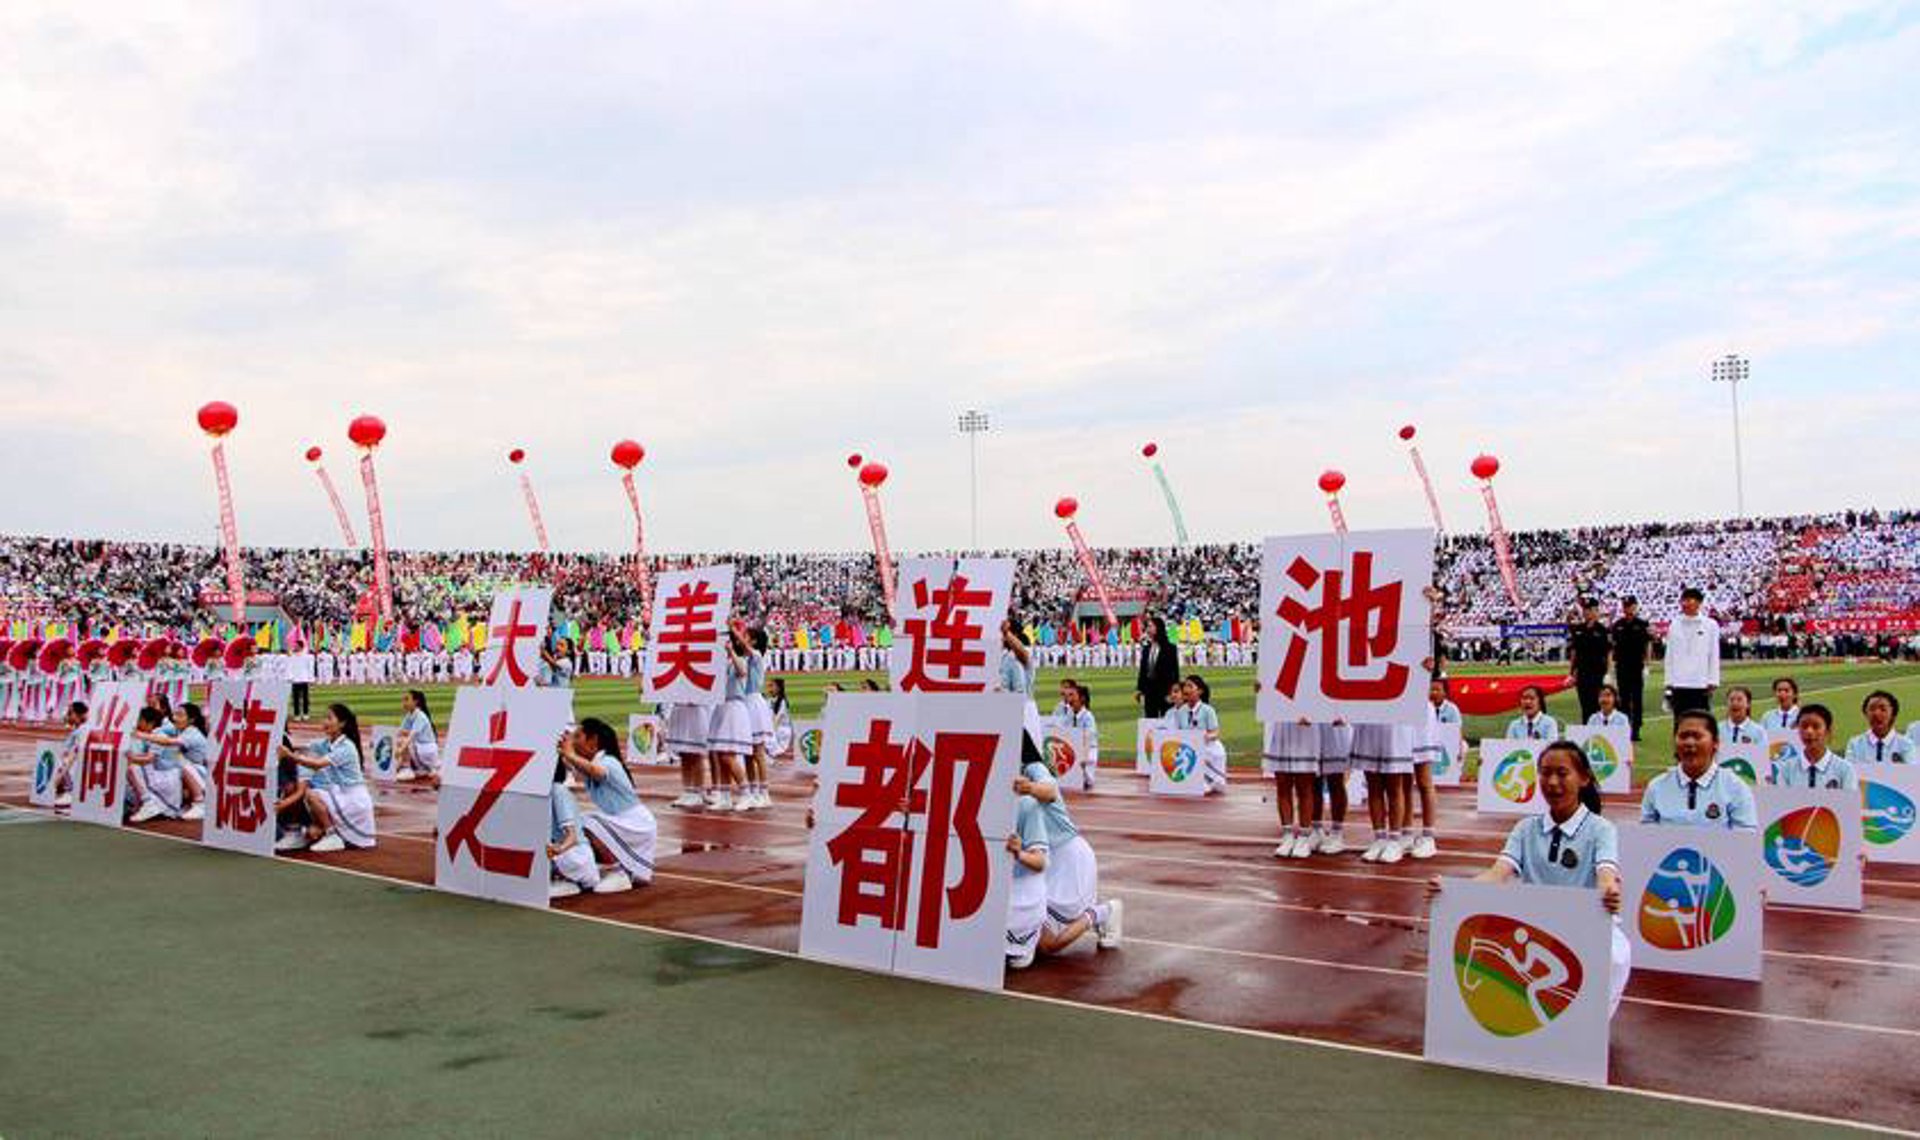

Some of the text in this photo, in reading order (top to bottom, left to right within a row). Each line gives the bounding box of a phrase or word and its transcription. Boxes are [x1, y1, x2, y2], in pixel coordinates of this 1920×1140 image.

[487, 600, 537, 686] 大
[653, 581, 718, 691] 美
[902, 576, 992, 693] 连
[1276, 552, 1408, 701] 池
[79, 695, 128, 806] 尚
[213, 682, 276, 832] 德
[446, 710, 534, 877] 之
[827, 720, 999, 949] 都
